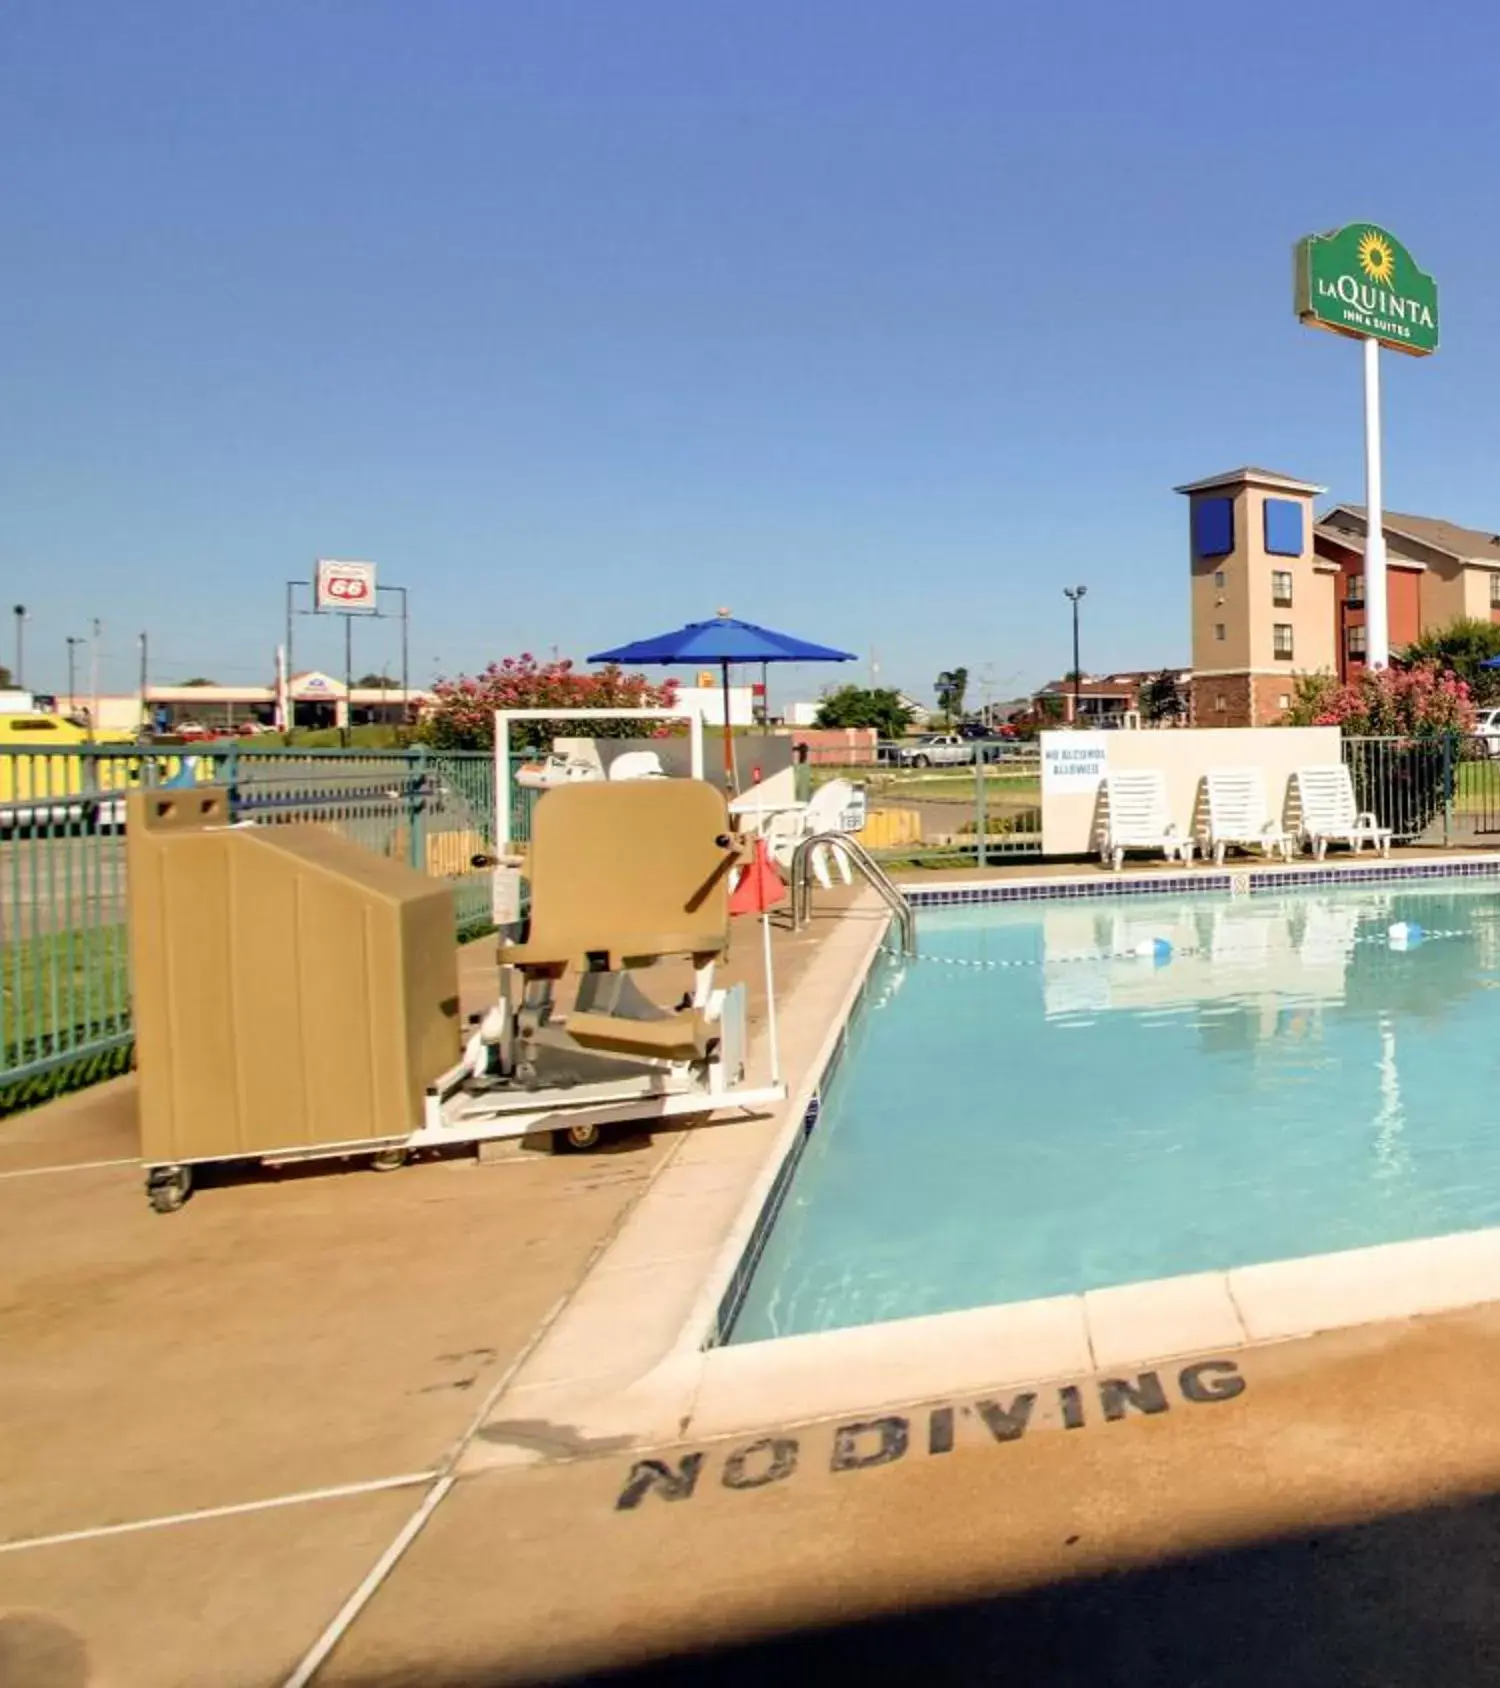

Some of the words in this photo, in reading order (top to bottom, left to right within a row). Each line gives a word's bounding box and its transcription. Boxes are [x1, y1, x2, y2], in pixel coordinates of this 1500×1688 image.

[1343, 309, 1363, 323] INN
[1373, 318, 1410, 338] SUITES
[331, 579, 363, 597] 66
[1045, 750, 1059, 760] NO
[1061, 749, 1105, 760] ALCOHOL
[1053, 764, 1099, 775] ALLOWED
[614, 1437, 800, 1511] NO
[829, 1359, 1247, 1473] DIVING
